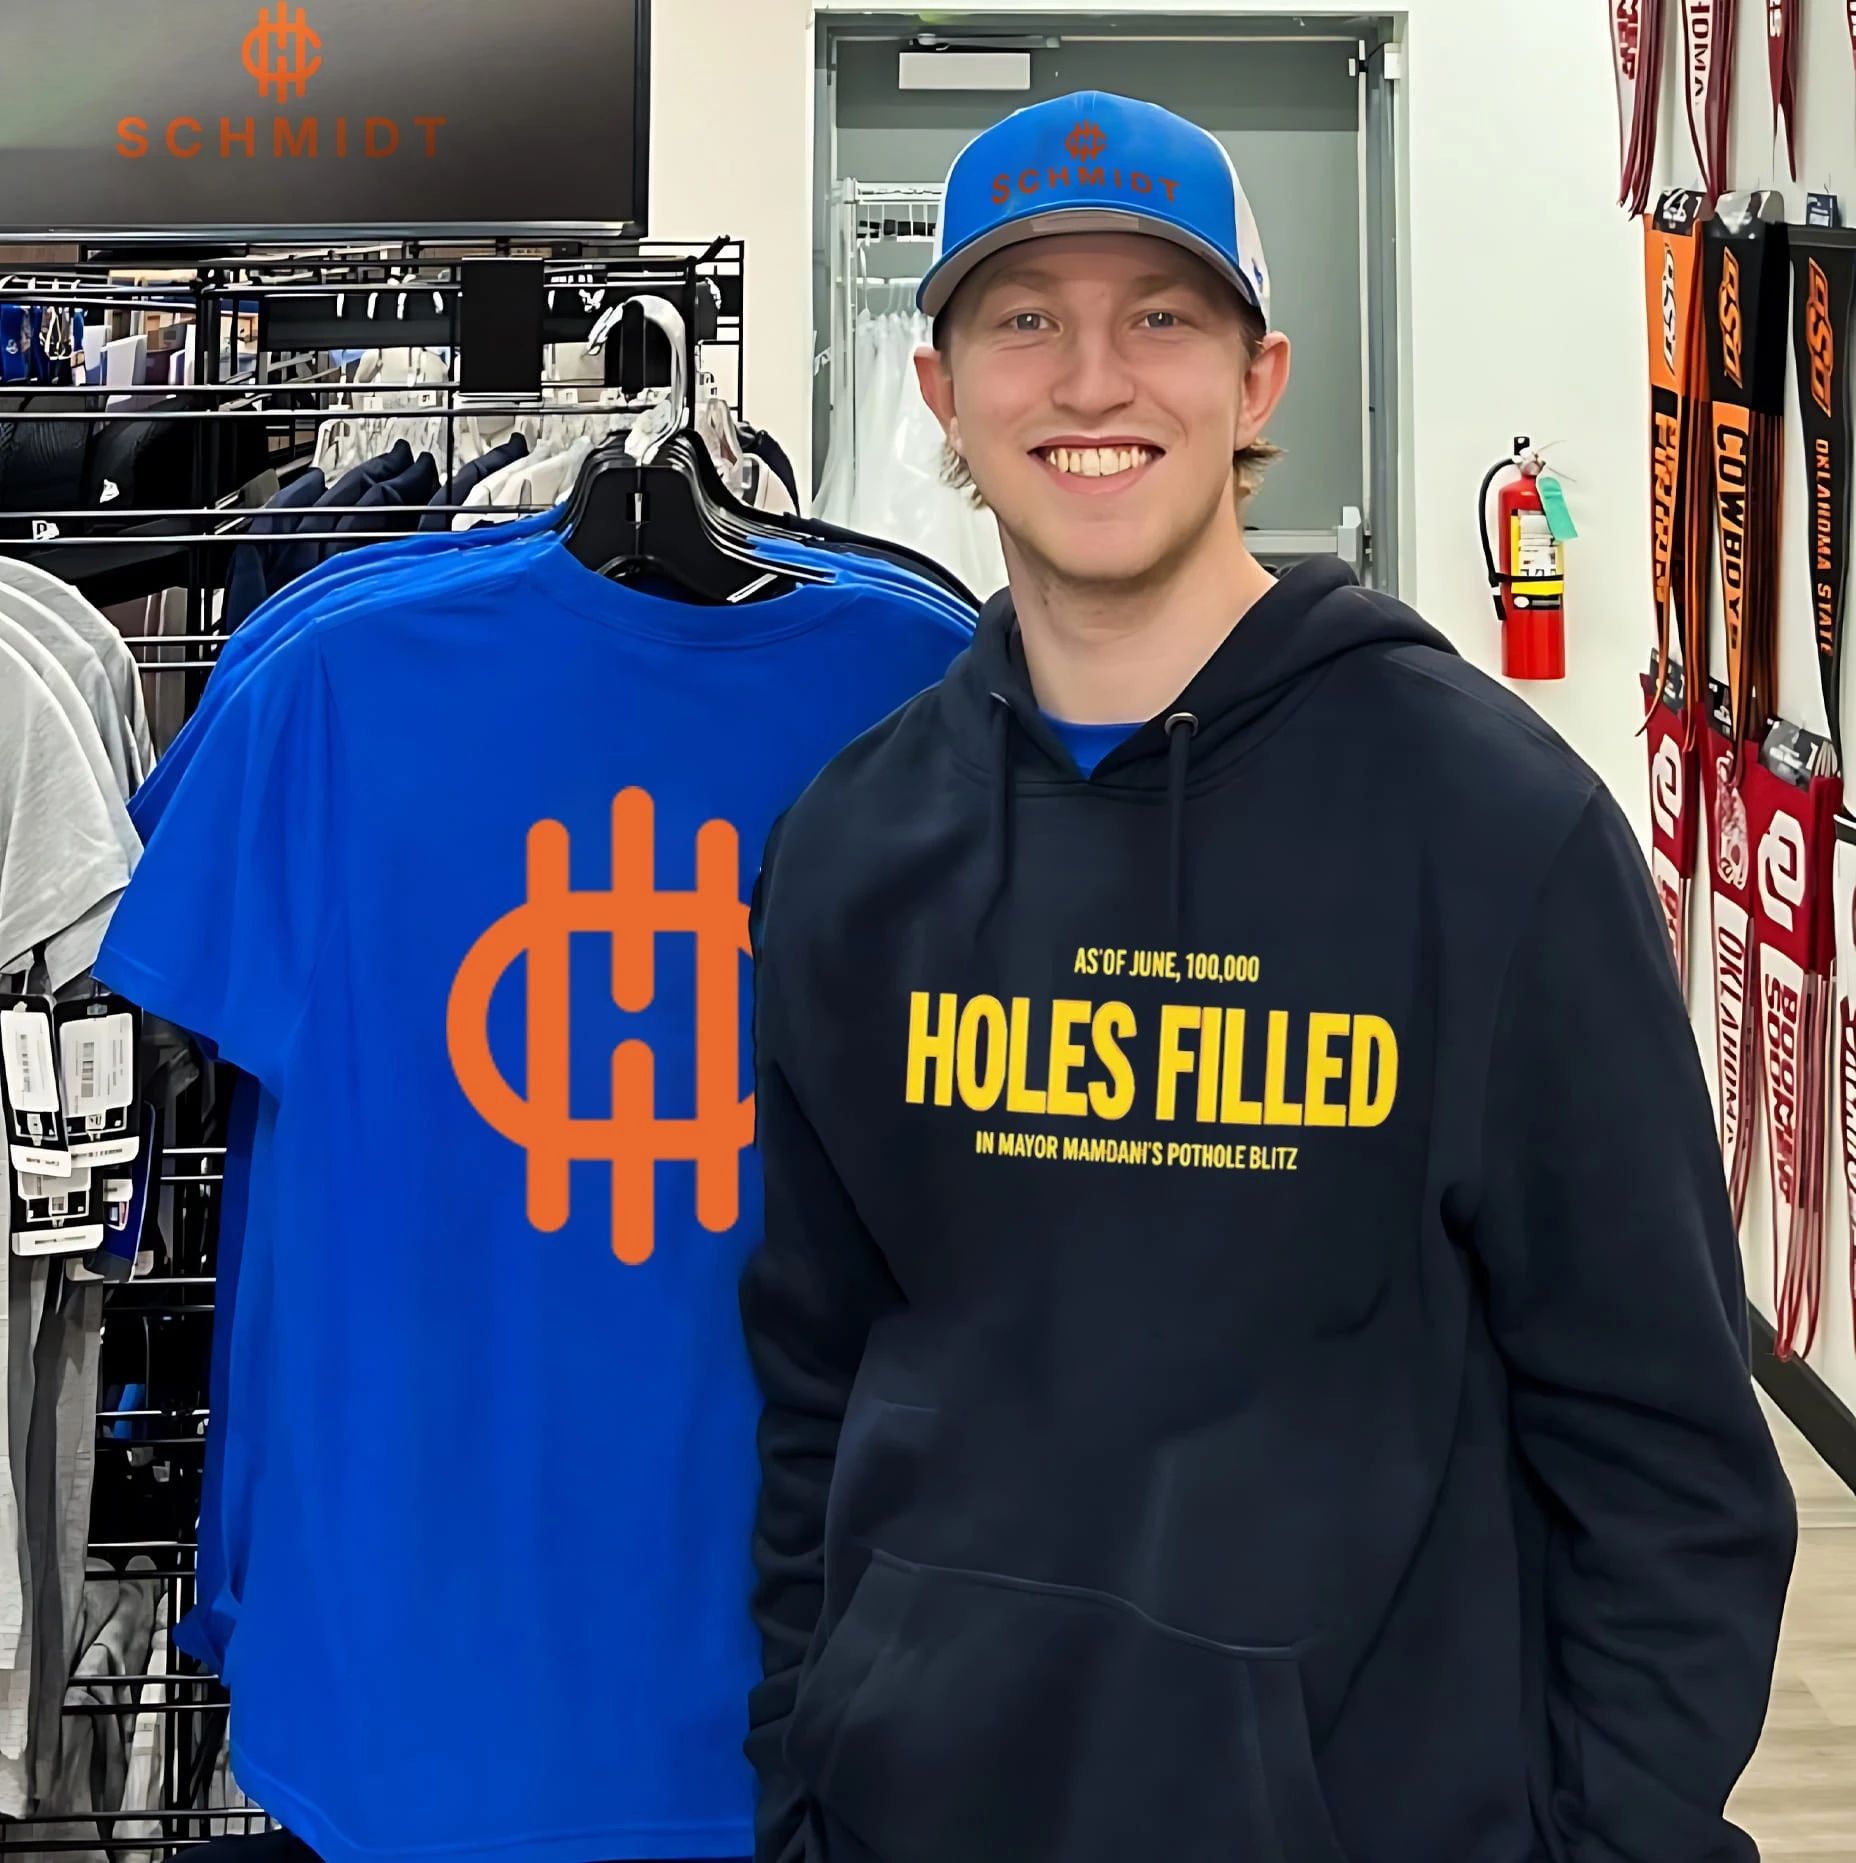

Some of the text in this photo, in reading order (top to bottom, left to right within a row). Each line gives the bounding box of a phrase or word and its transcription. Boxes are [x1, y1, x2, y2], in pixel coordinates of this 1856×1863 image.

[116, 116, 447, 159] SCHMIDT
[992, 166, 1181, 204] SCHMIDT
[1815, 438, 1832, 570] OKLAHOMA
[1074, 947, 1260, 983] AS OF JUNE, 100,000
[1718, 926, 1745, 1144] OKLAHOMA
[906, 991, 1399, 1127] HOLES FILLED
[976, 1130, 1298, 1171] IN MAYOR MAMDANI'S POTHOLE BLITZ
